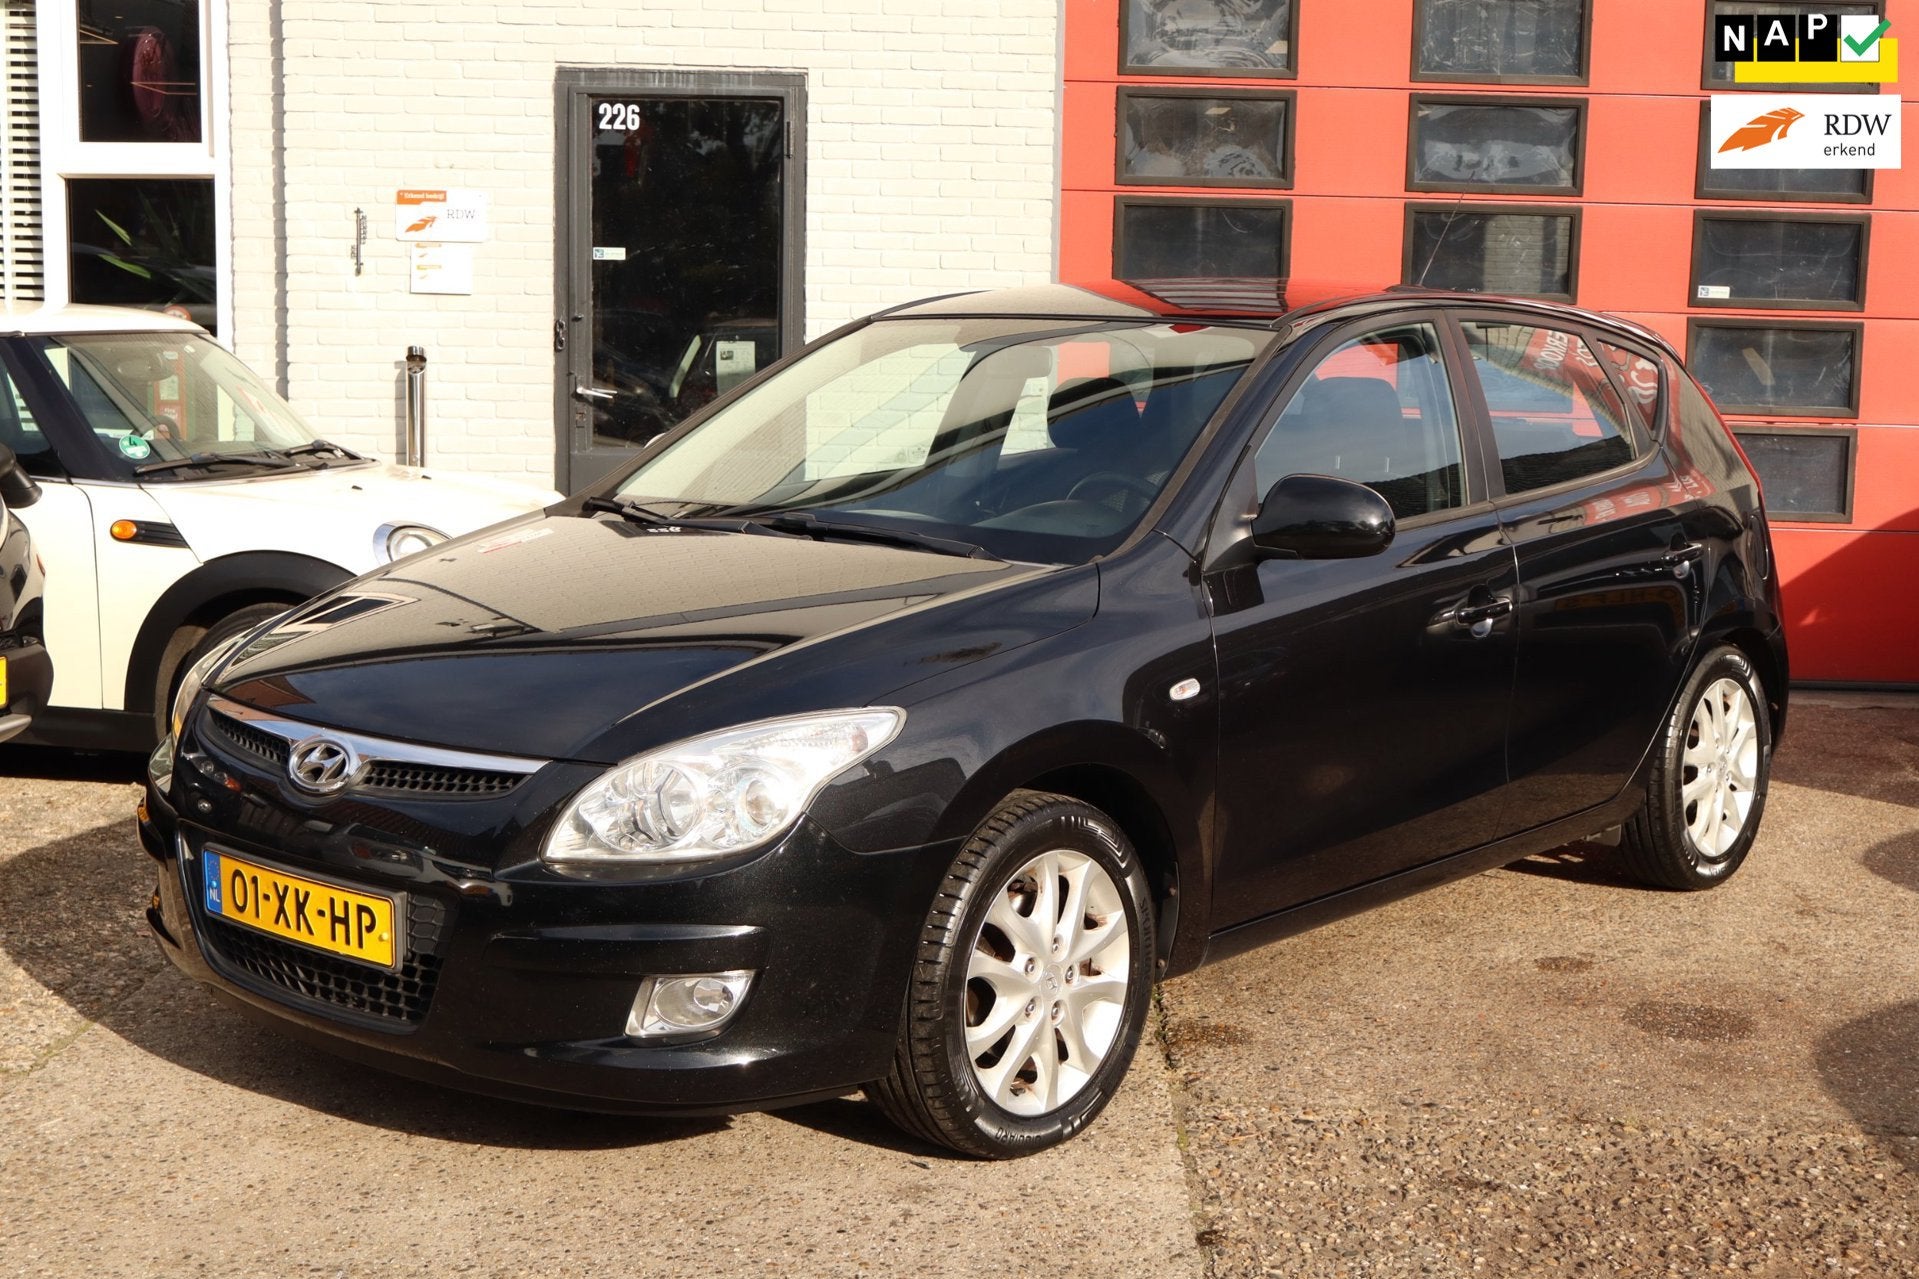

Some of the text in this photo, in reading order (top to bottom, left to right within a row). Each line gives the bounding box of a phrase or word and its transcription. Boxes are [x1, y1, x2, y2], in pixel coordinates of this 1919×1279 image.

[598, 102, 640, 131] 226
[447, 209, 475, 219] RDW
[209, 888, 221, 903] NL
[231, 868, 377, 950] 01-XK-HP
